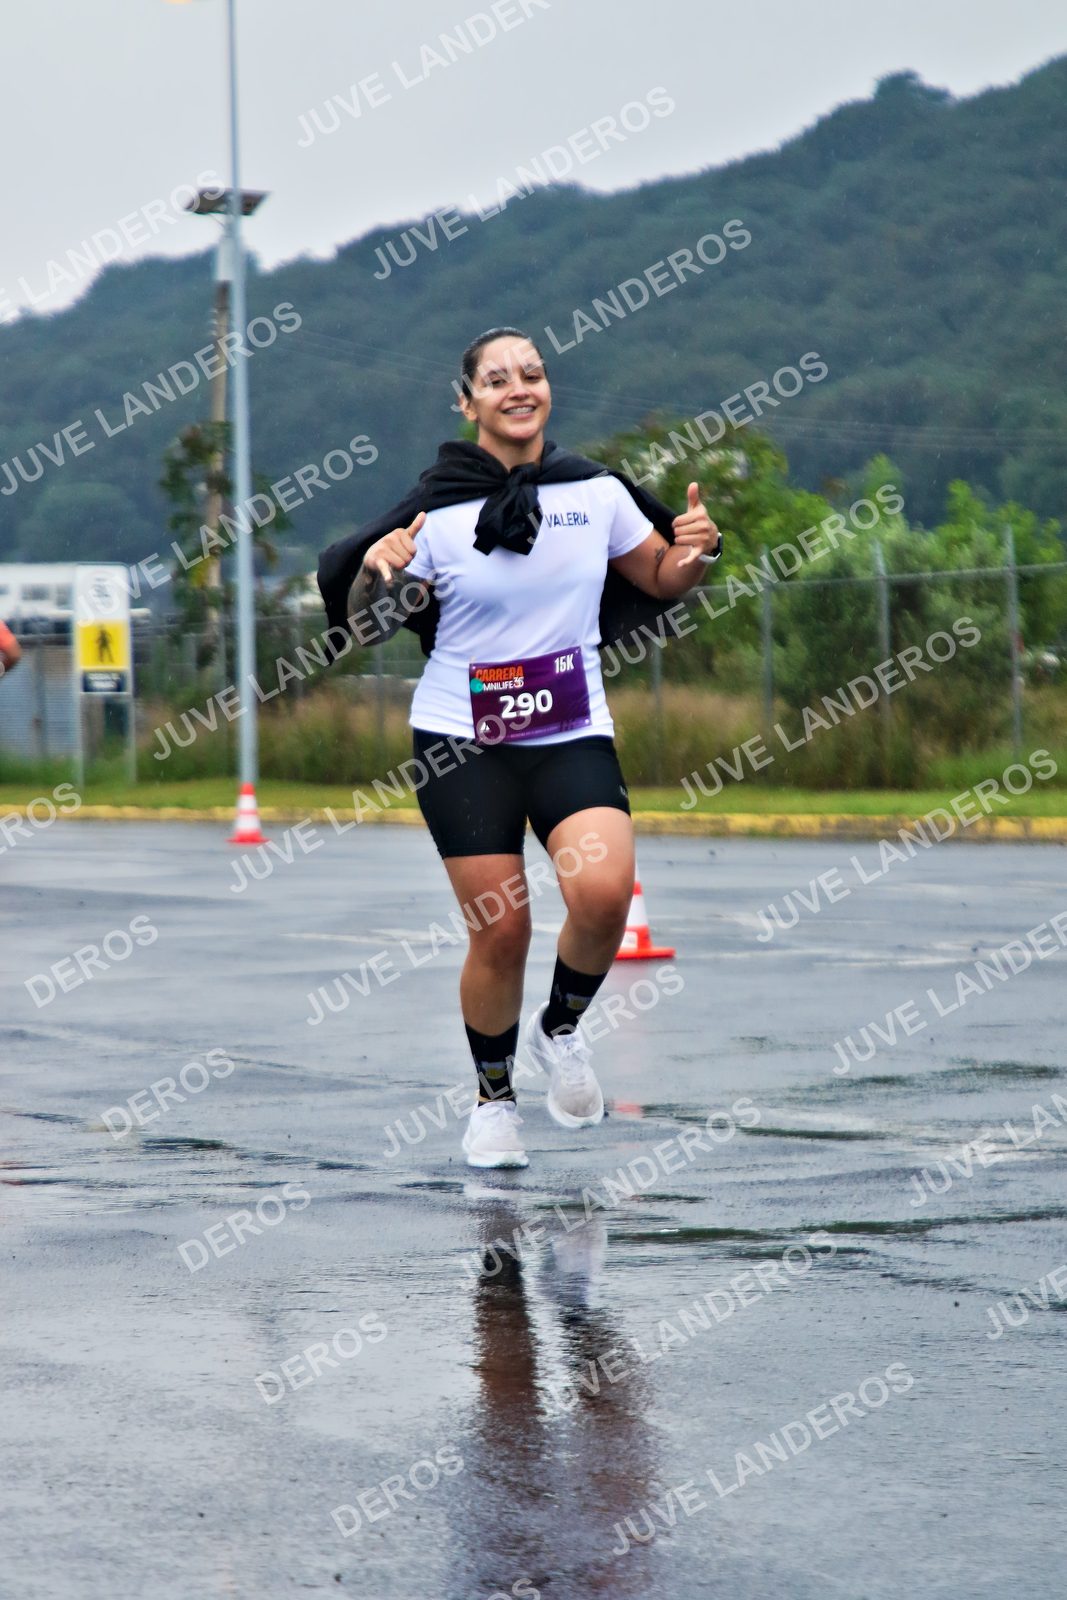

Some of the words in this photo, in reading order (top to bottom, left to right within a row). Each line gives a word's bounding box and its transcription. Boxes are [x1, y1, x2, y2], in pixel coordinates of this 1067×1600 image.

[545, 512, 590, 528] VALERIA
[475, 665, 524, 682] CARRERA
[499, 689, 553, 719] 290
